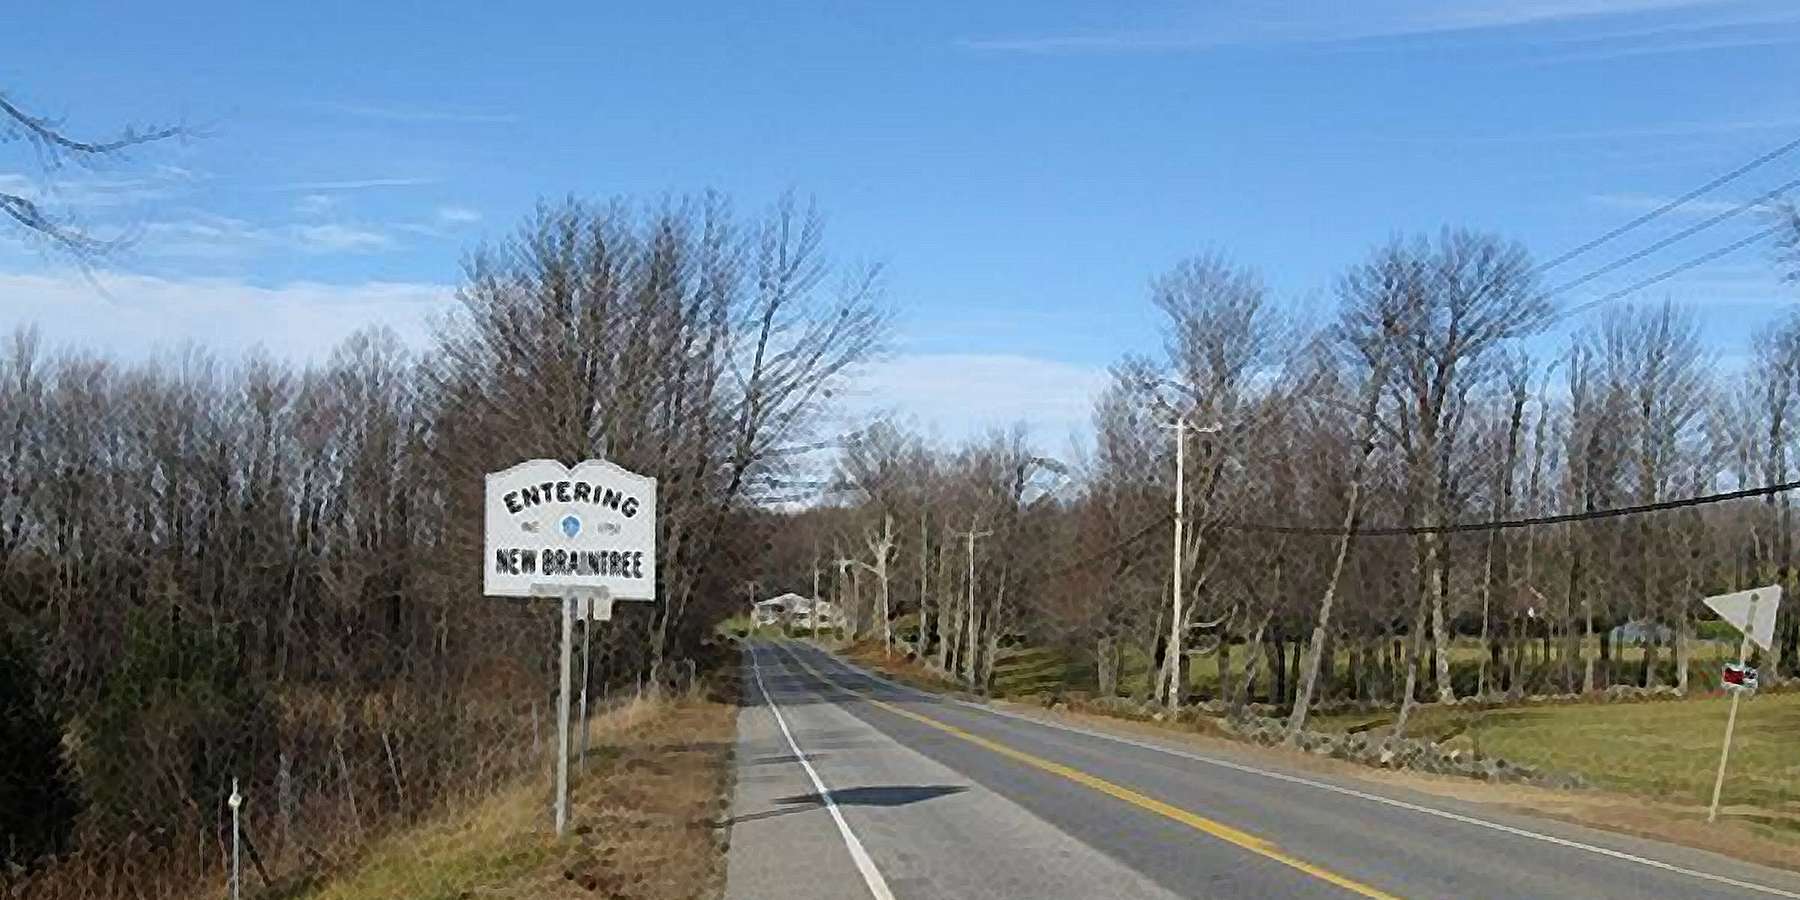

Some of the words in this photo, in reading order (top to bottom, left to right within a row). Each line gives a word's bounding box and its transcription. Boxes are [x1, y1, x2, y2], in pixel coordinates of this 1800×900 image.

[503, 481, 640, 518] ENTERING
[496, 549, 537, 576] NEW
[542, 549, 644, 579] BRAINTREE
